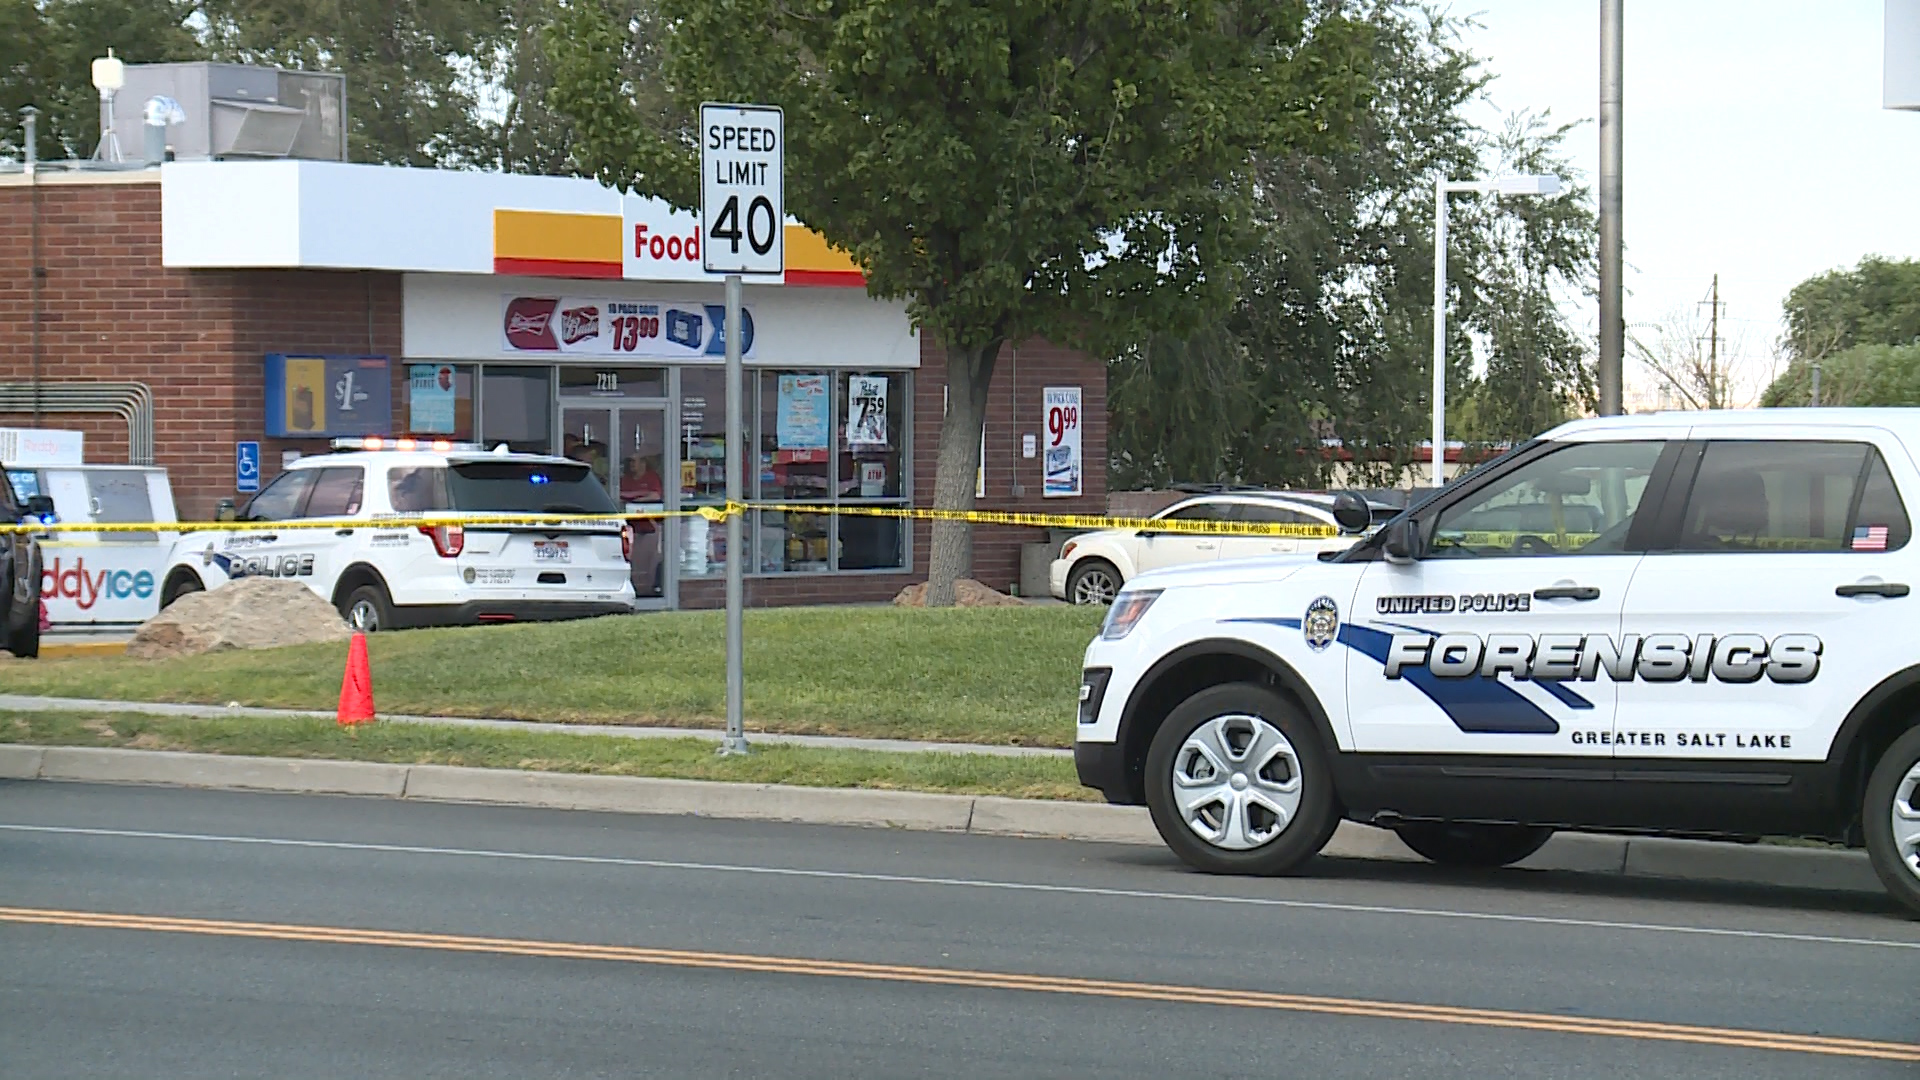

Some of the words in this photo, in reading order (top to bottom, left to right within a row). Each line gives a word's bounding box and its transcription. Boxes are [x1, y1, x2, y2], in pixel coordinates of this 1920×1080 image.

[709, 126, 775, 151] SPEED
[716, 161, 768, 185] LIMIT
[710, 195, 776, 255] 40
[634, 224, 700, 261] Food
[1307, 526, 1322, 536] LINE
[228, 553, 315, 579] POLICE
[42, 557, 154, 610] ddyice
[1376, 595, 1456, 614] UNIFIED
[1459, 593, 1531, 613] POLICE
[1383, 633, 1824, 684] FORENSICS
[1571, 731, 1666, 746] GREATER
[1677, 733, 1727, 748] SALT
[1736, 734, 1792, 749] LAKE
